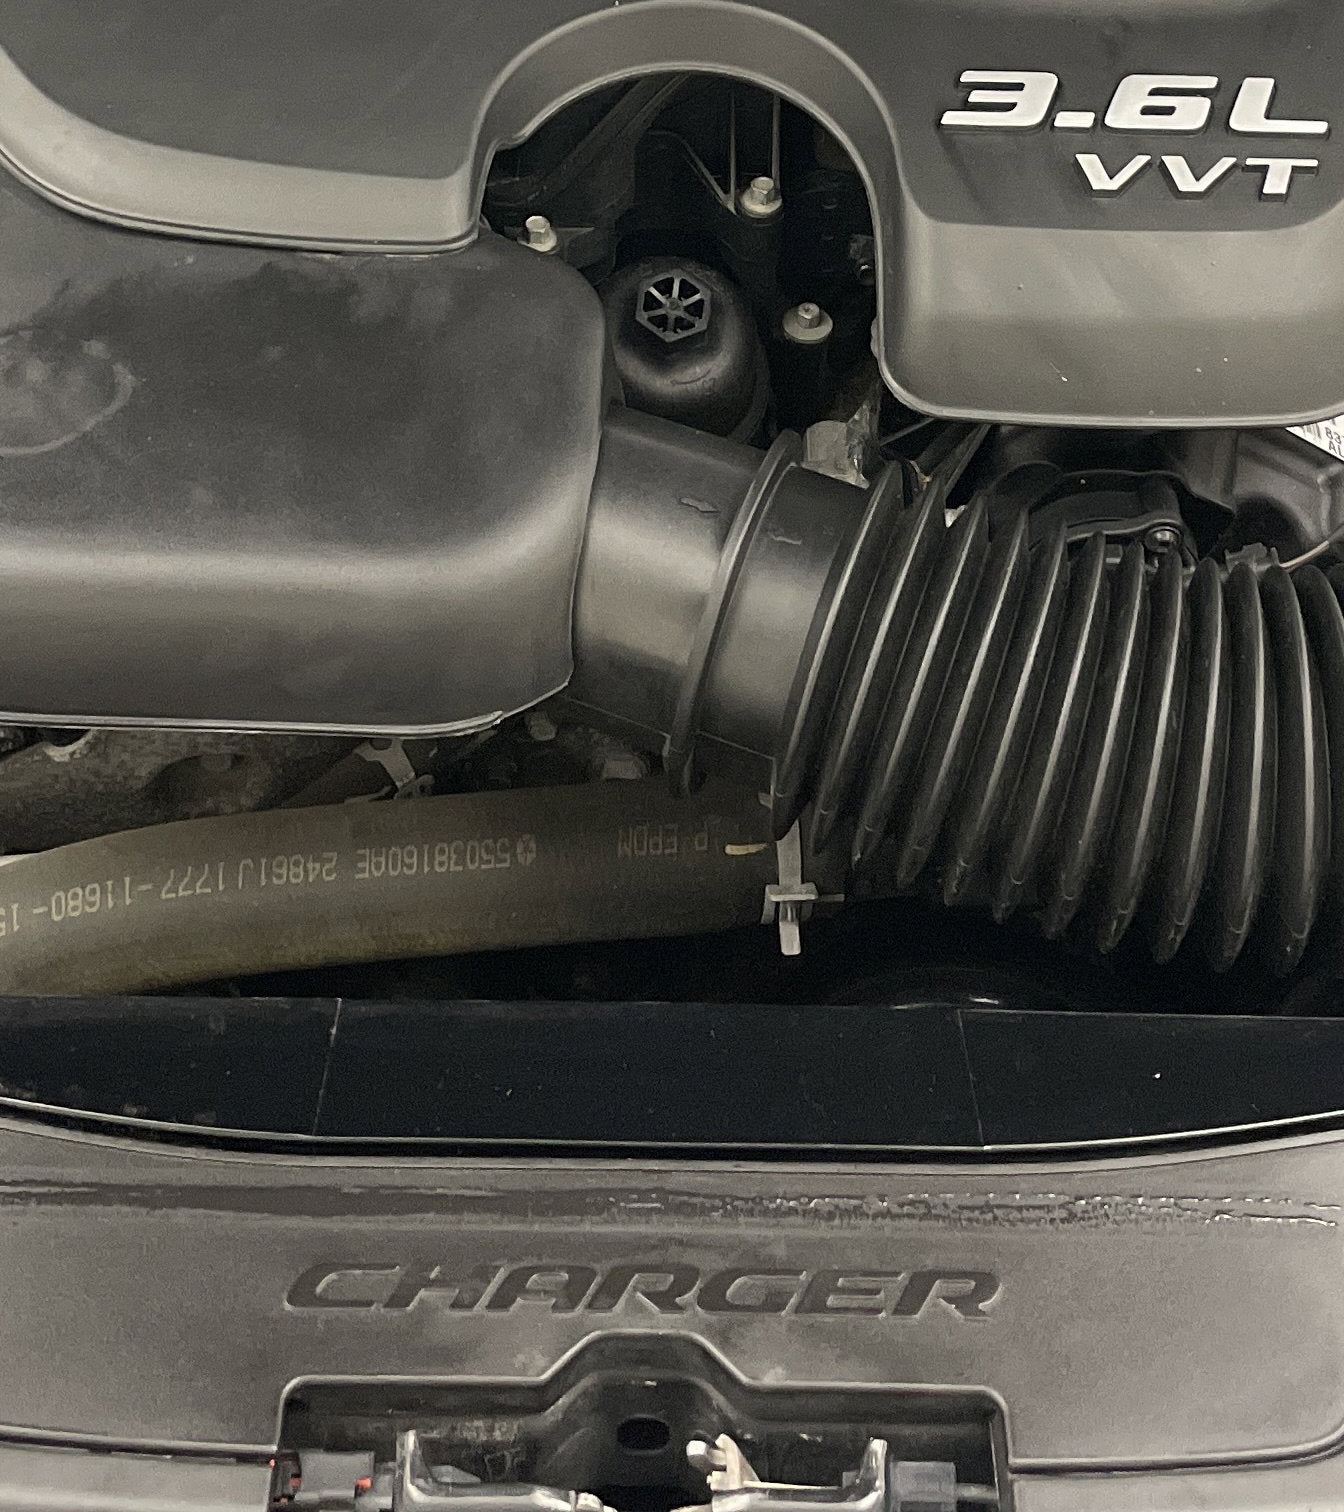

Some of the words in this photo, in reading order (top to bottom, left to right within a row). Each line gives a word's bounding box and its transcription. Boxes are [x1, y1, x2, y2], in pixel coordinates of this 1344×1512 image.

[941, 70, 1330, 136] 3.6L
[1075, 153, 1319, 199] VVT
[285, 1262, 1003, 1319] CHARGER
